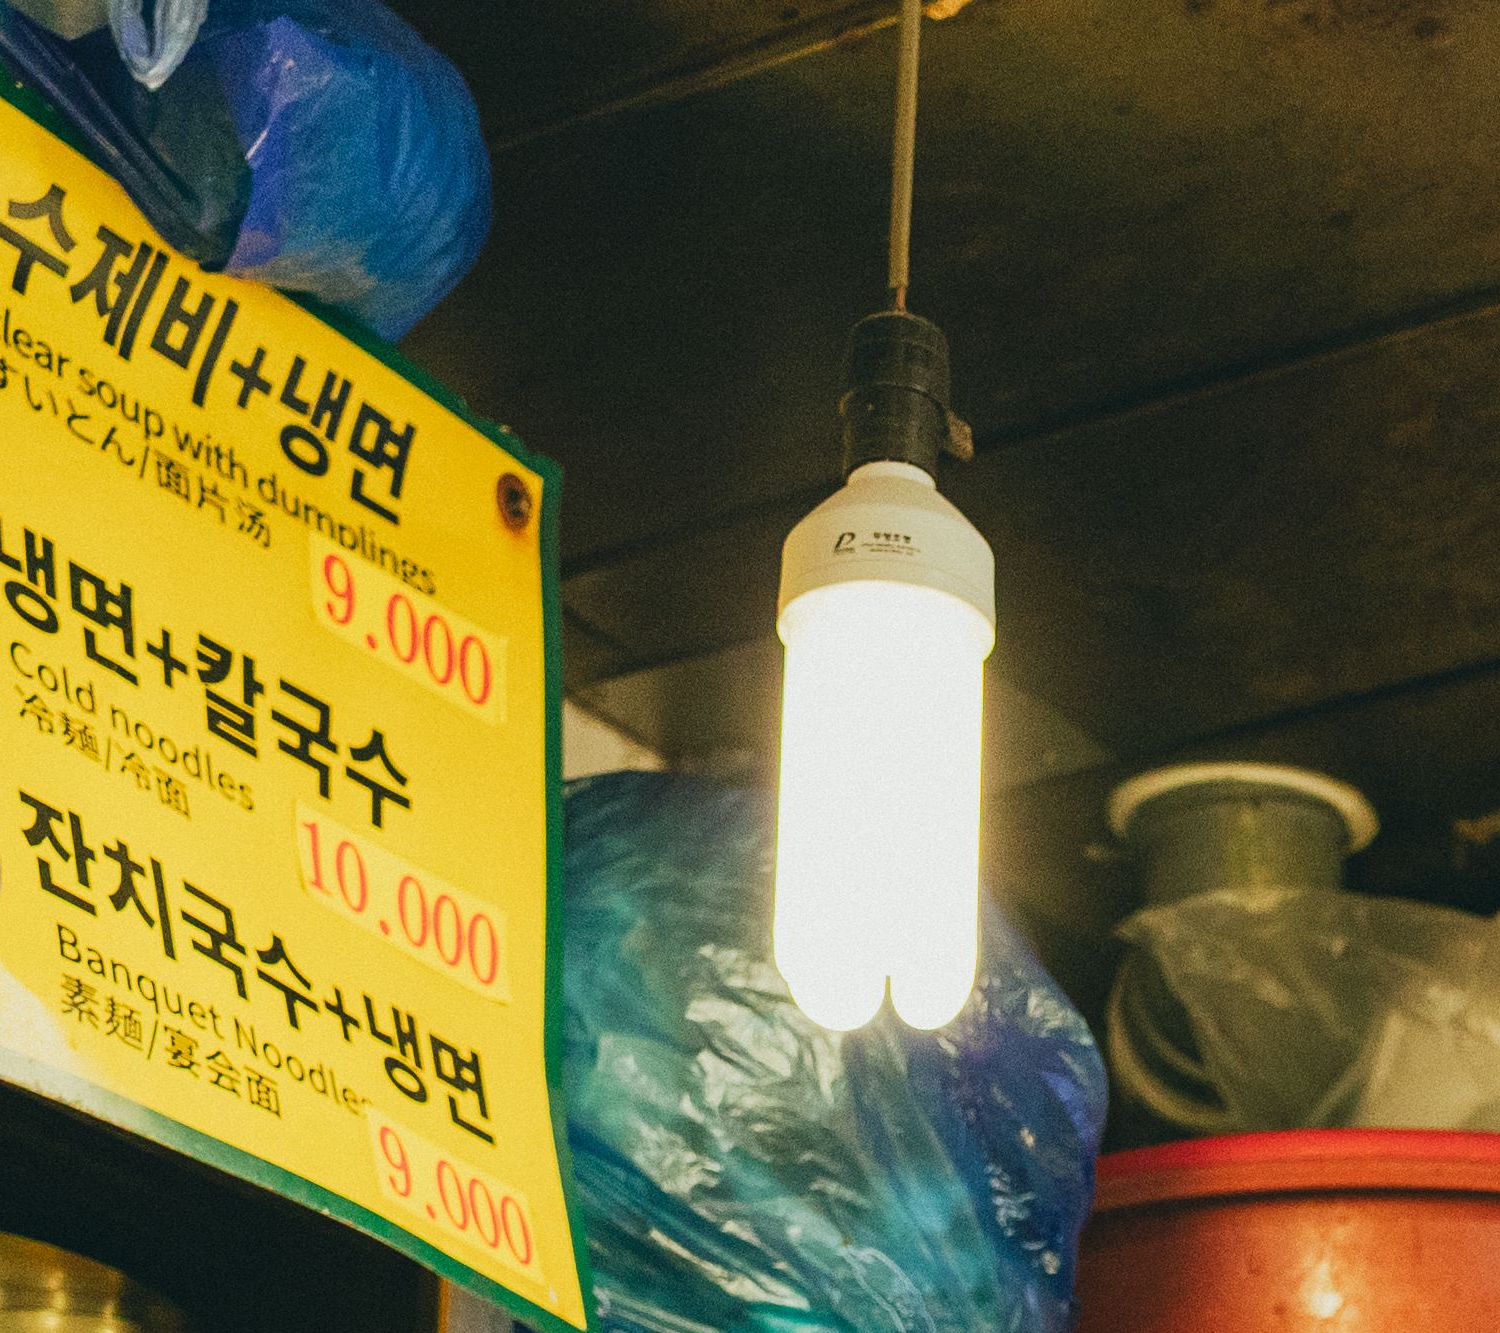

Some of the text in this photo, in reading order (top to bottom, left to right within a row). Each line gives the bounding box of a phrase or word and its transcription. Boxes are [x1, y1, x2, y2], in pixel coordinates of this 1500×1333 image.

[78, 366, 164, 439] soup
[172, 424, 249, 490] with
[257, 473, 437, 595] dumplings
[323, 554, 491, 705] 9.000
[11, 641, 255, 812] Cold noodles
[19, 790, 496, 1146] 잔치국수+냉면
[57, 922, 225, 1041] Banquet
[303, 821, 499, 987] 10.000
[378, 1125, 533, 1267] 9.000
